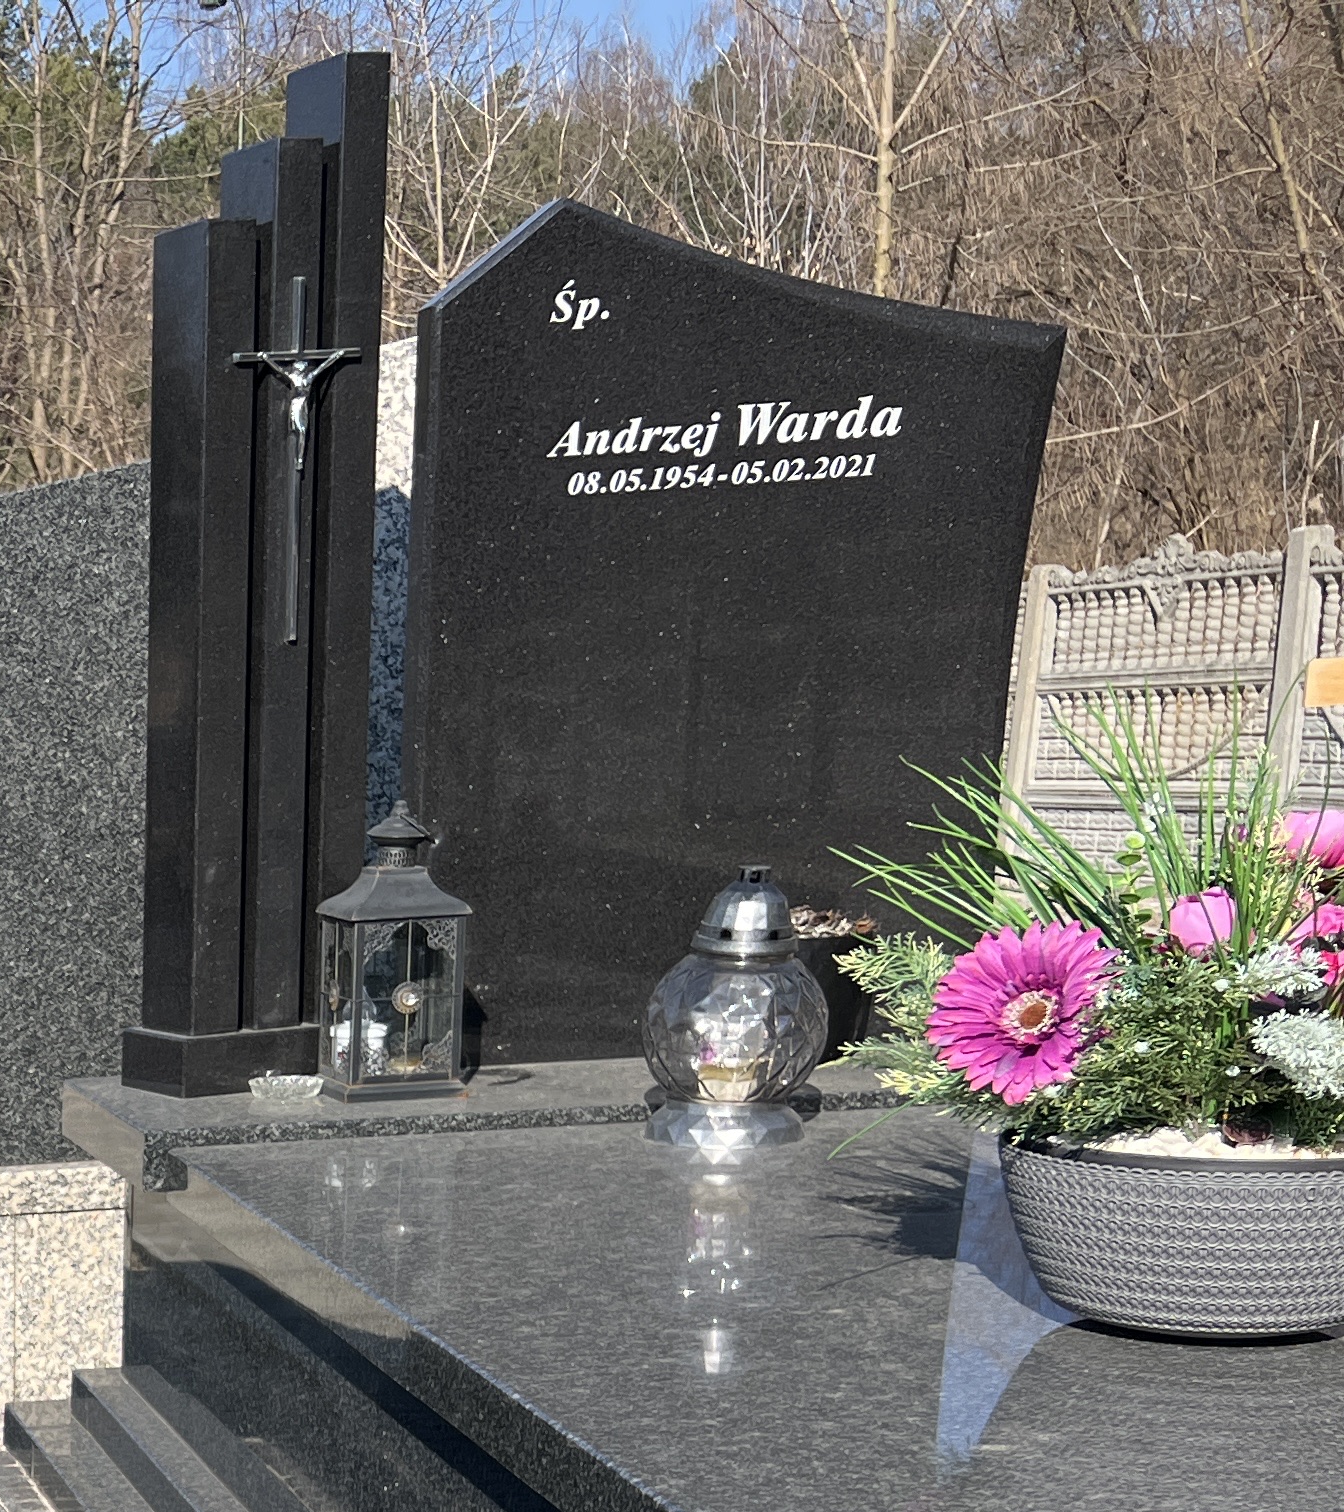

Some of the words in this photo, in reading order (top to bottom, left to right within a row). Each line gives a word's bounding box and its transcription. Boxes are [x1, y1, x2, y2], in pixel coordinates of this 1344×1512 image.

[548, 279, 611, 330] Śp.
[546, 411, 722, 458] Andrzej
[736, 395, 903, 447] Warda
